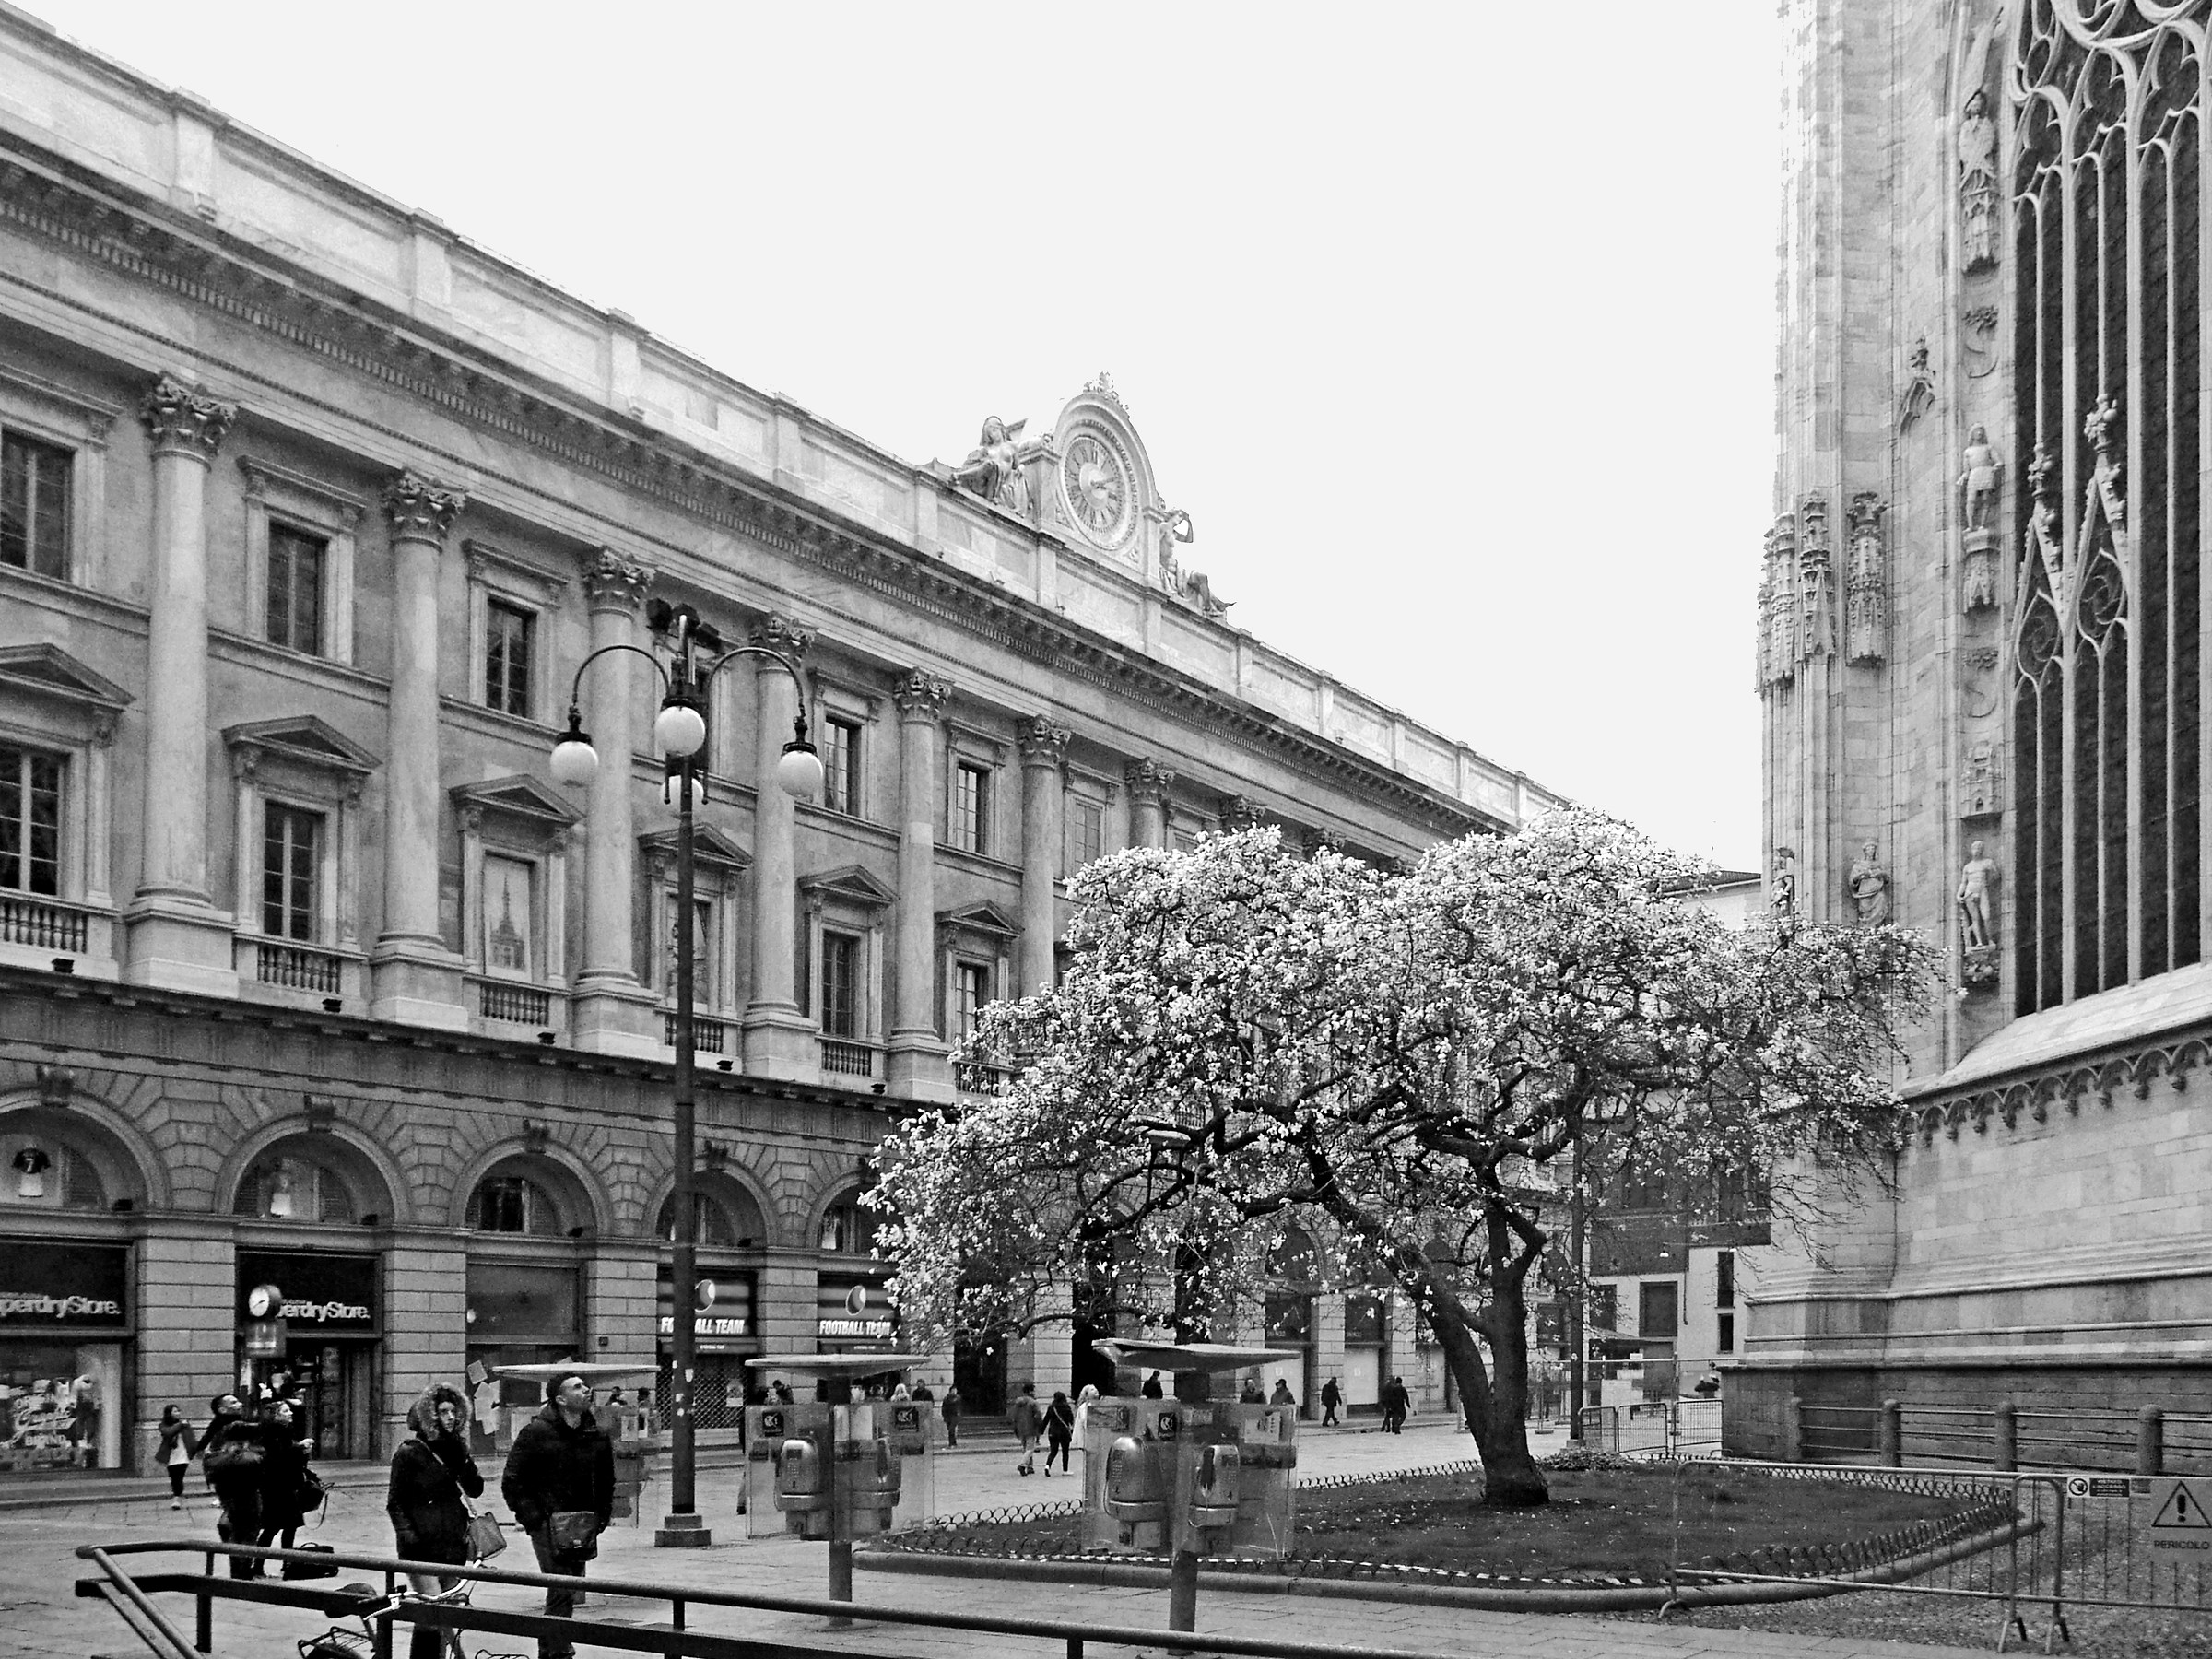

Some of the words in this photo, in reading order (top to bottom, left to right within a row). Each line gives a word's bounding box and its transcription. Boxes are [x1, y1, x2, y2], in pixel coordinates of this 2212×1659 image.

[661, 1316, 713, 1334] FOALL
[715, 1318, 745, 1335] TEAM
[819, 1320, 864, 1335] FOOTBALL
[865, 1321, 892, 1335] TEAM
[2153, 1539, 2210, 1550] PERICOLO
